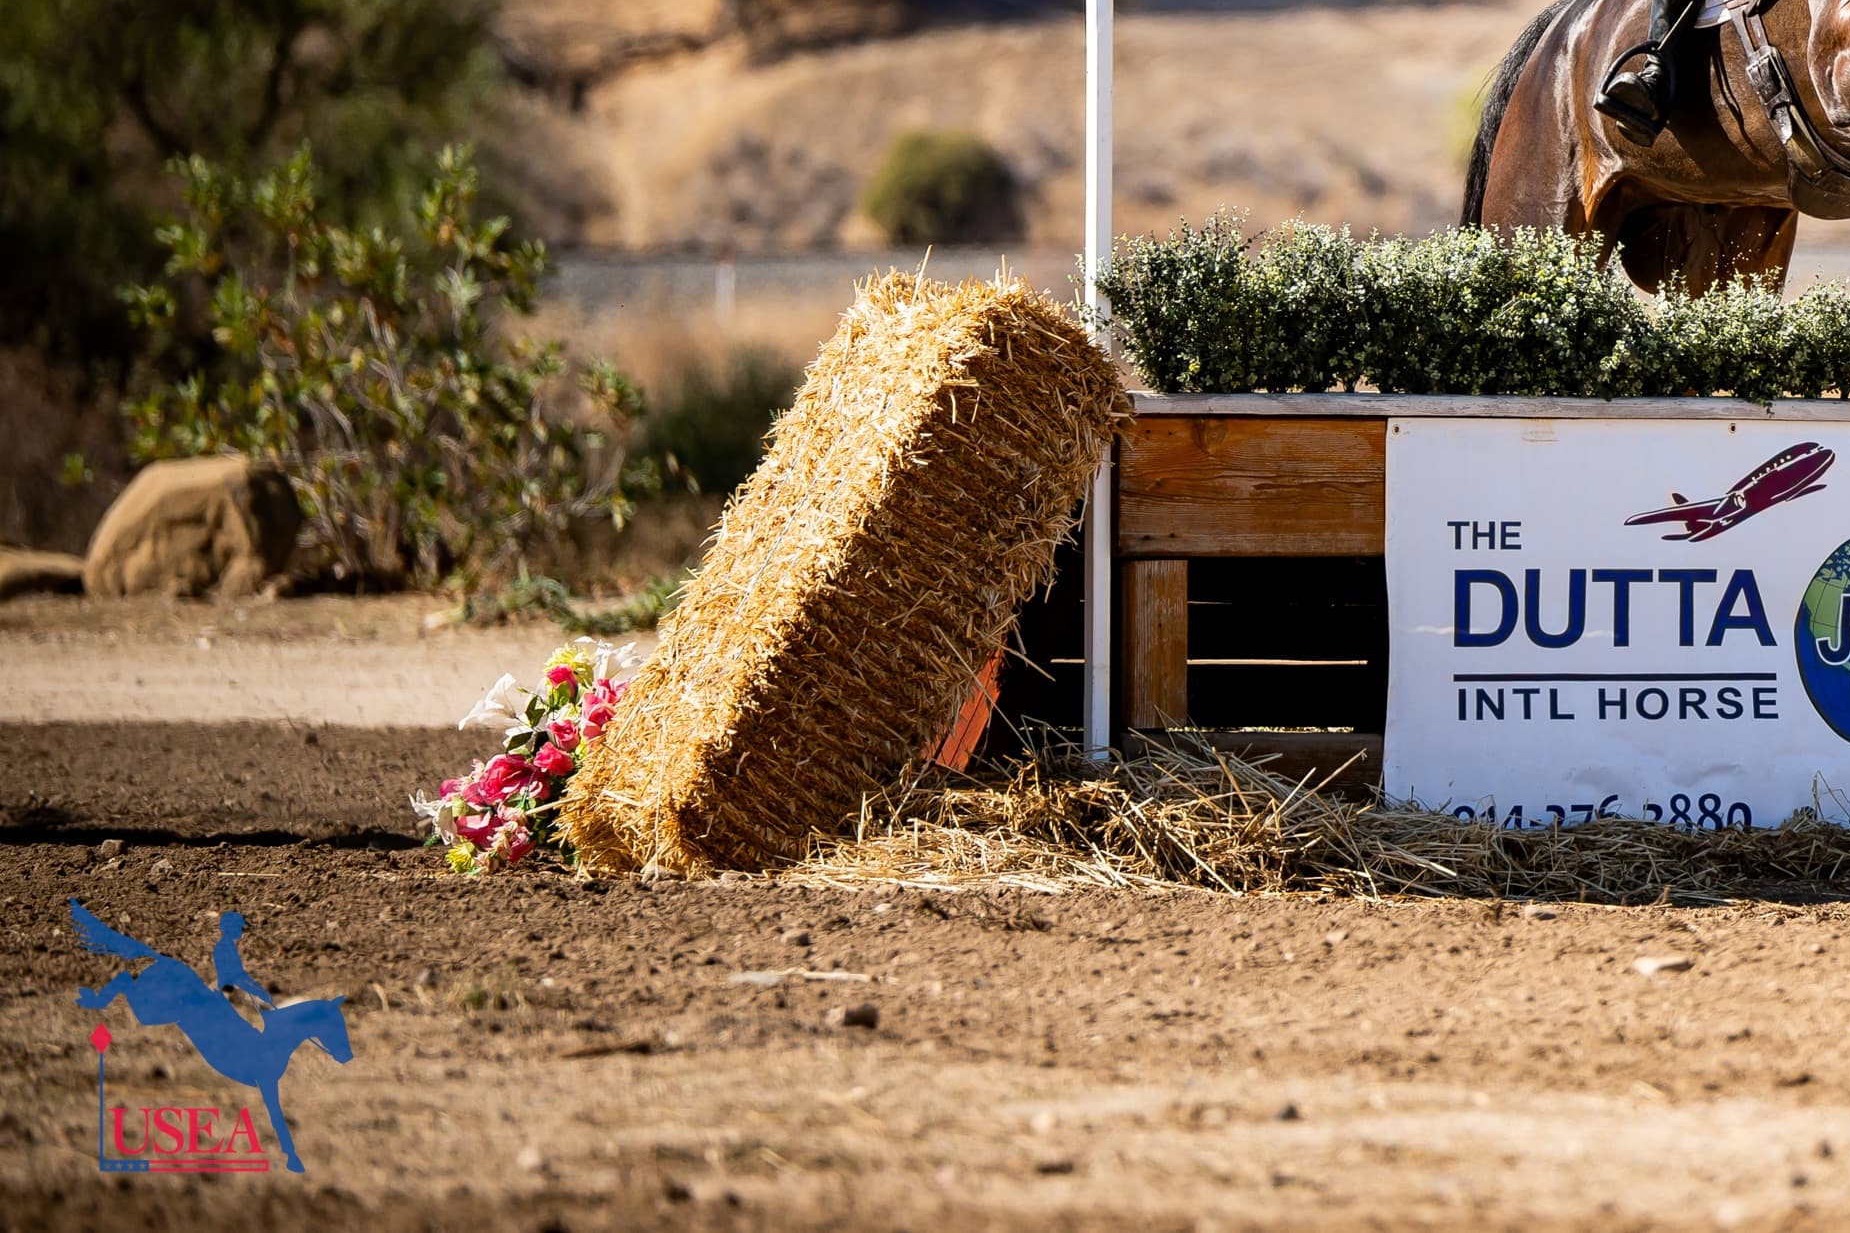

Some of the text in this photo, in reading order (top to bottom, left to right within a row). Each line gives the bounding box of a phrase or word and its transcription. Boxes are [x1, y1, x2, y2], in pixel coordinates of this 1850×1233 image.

[1447, 521, 1522, 551] THE
[1453, 568, 1779, 649] DUTTA
[1457, 687, 1576, 722] INTL
[1597, 686, 1780, 722] HORSE
